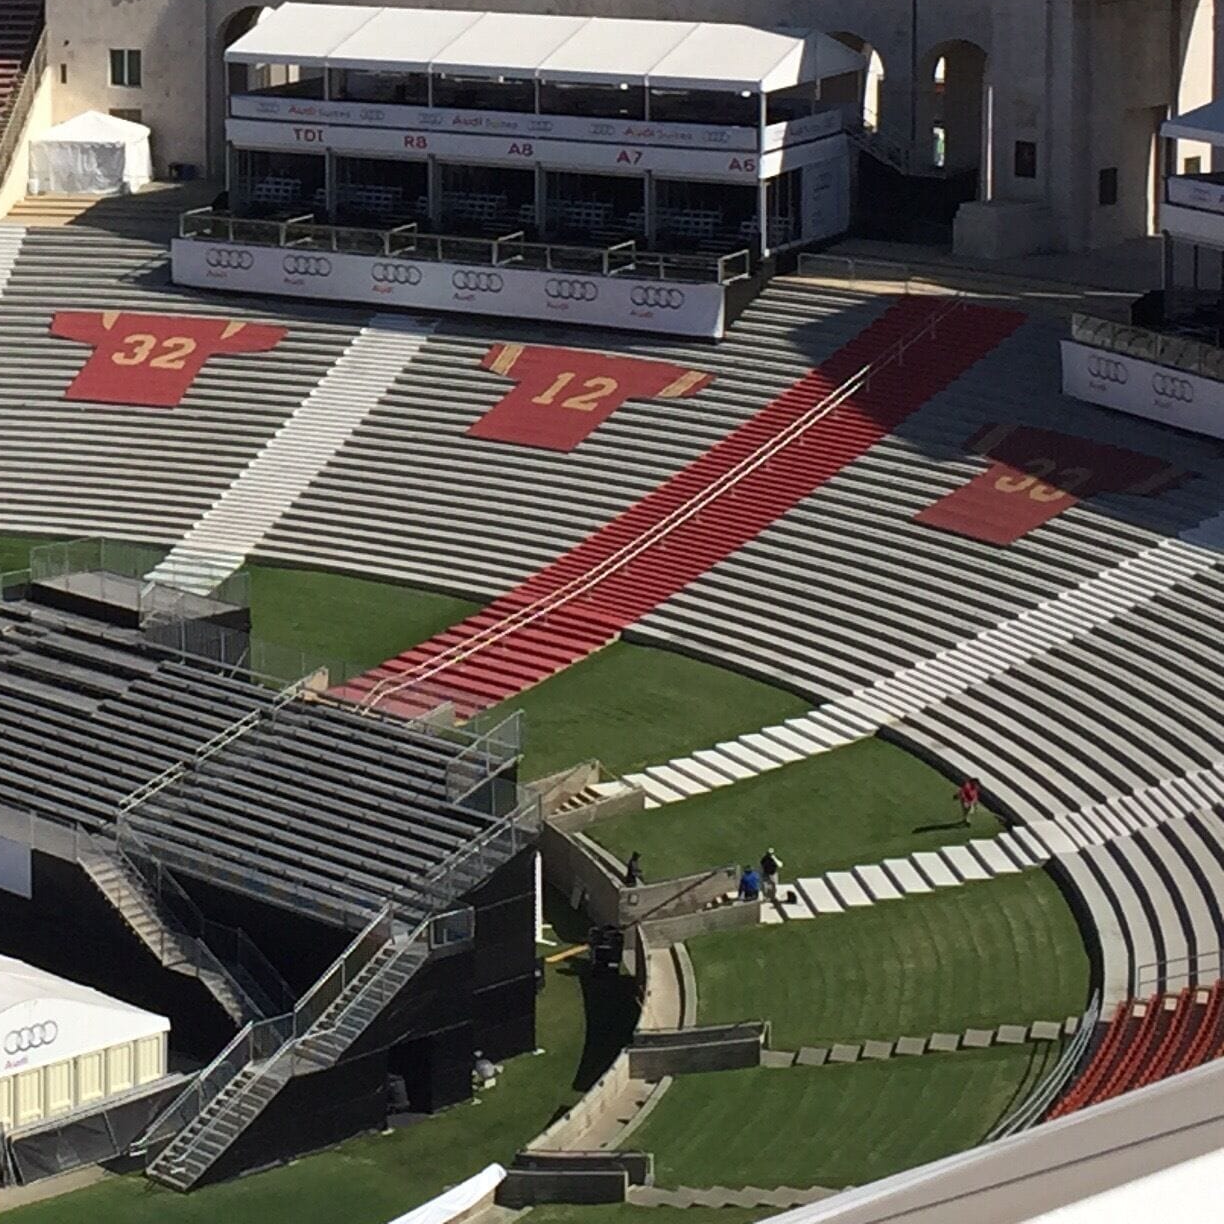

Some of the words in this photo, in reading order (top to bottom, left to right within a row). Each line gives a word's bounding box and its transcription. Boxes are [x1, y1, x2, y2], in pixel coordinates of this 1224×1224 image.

[293, 127, 324, 143] TDI
[403, 135, 429, 150] R8
[507, 142, 534, 157] A8
[616, 151, 643, 166] A7
[728, 158, 756, 173] A6
[110, 333, 196, 370] 32
[529, 371, 620, 411] 12
